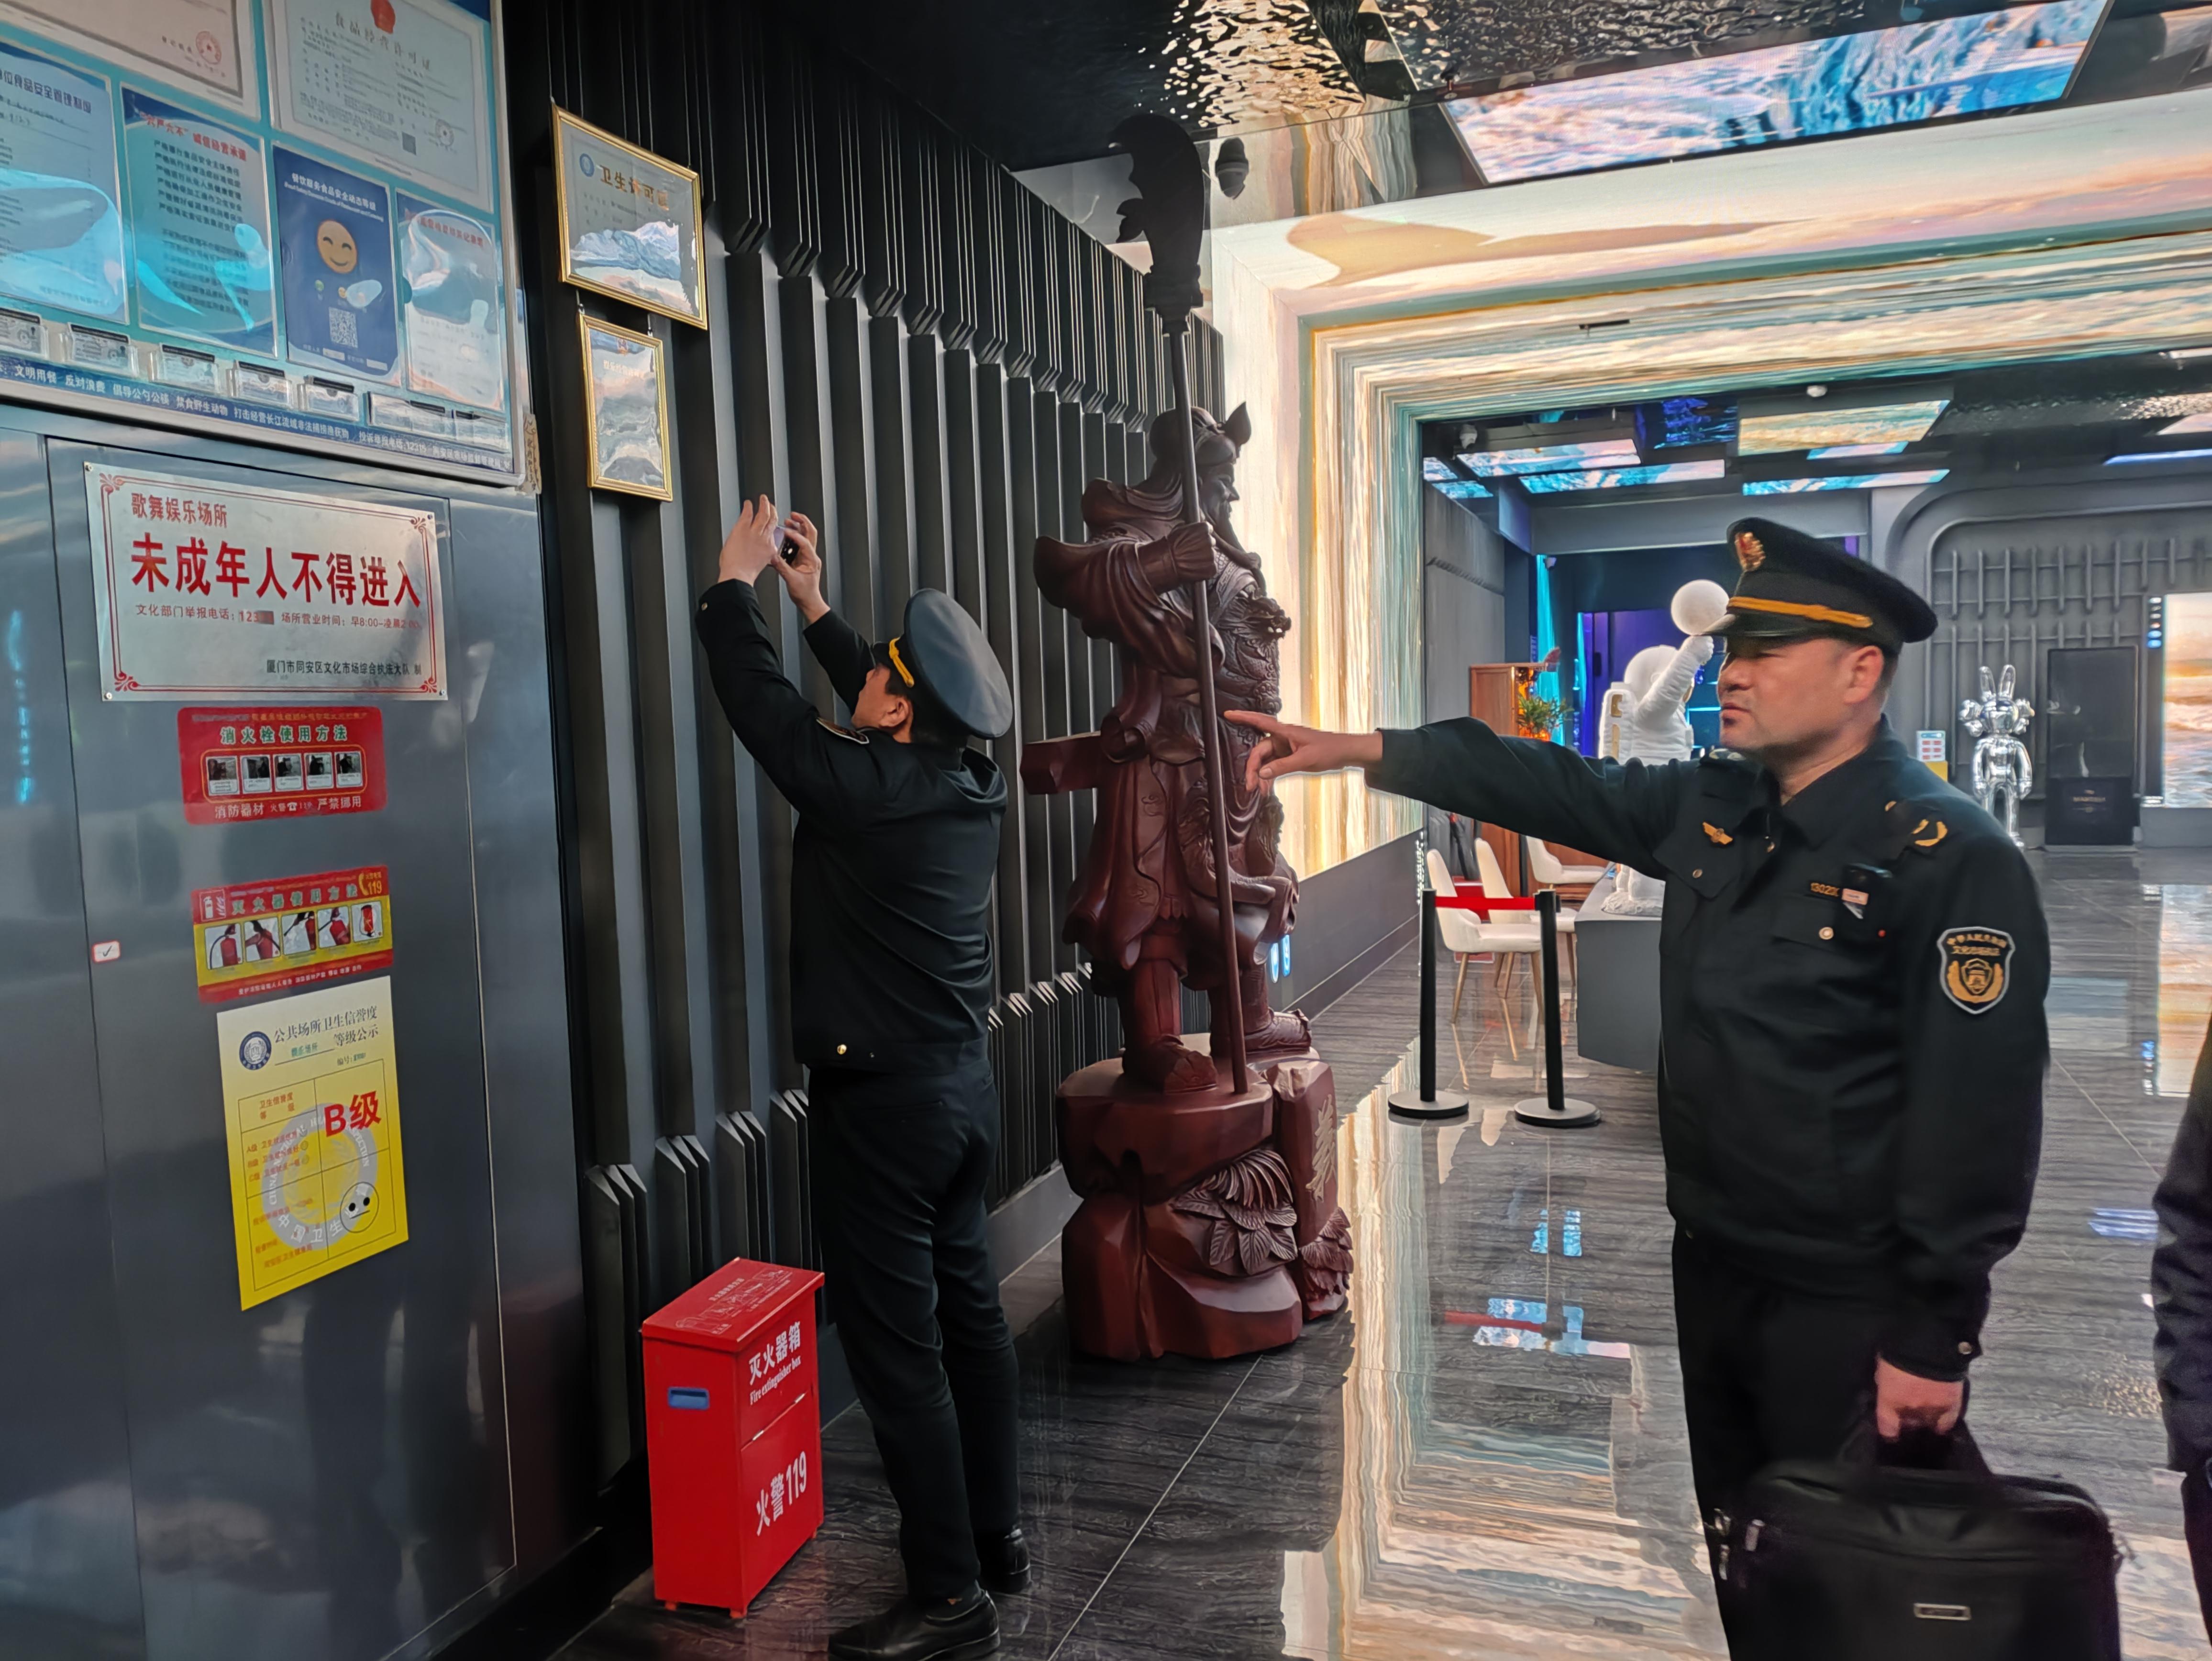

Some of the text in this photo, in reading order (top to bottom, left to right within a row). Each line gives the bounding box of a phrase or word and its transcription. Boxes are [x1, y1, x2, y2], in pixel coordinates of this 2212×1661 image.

[15, 365, 57, 384] 文明用餐
[65, 374, 106, 393] 反对浪费
[113, 384, 170, 406] 倡导公勺公筷
[177, 396, 228, 416] 禁食野生动物
[131, 492, 228, 528] 歌舞娱乐场所
[131, 532, 421, 608] 未成年人不得进入
[220, 724, 348, 745] 消火栓使用方法
[215, 803, 264, 819] 消防器材
[317, 796, 362, 811] 严禁挪用
[368, 880, 382, 894] 119
[274, 1006, 377, 1043] 公共场所卫生信誉度
[334, 1024, 378, 1046] 等级公示
[324, 1090, 382, 1138] B级
[749, 1321, 800, 1385] 灭火器箱
[750, 1356, 801, 1406] Fire extinguisher box
